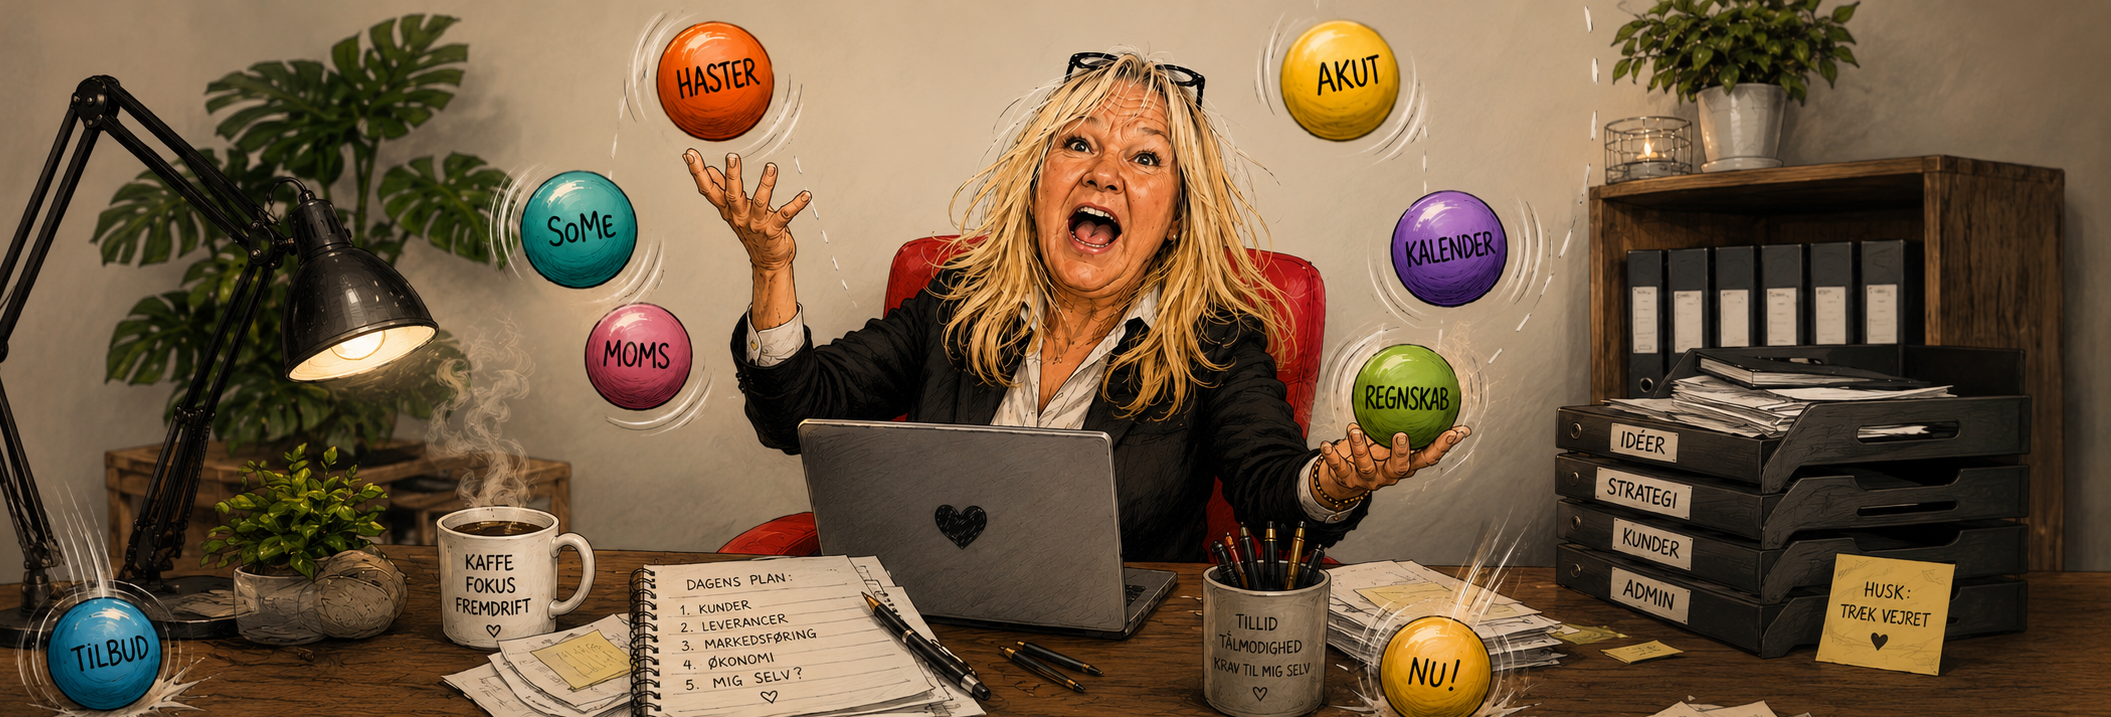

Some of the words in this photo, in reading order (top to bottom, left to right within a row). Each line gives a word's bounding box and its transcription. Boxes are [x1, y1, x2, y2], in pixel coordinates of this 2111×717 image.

[676, 57, 760, 99] HASTER
[1317, 54, 1380, 96] AKUT
[1405, 230, 1496, 268] KALENDER
[602, 339, 670, 370] MOMS
[1365, 384, 1449, 411] REGNSKAB
[1620, 429, 1666, 455] IDÉER
[1607, 477, 1677, 509] STRATEGI
[1622, 527, 1680, 559] KUNDER
[465, 553, 514, 572] KAFFE
[465, 575, 516, 594] FOKUS
[686, 576, 741, 591] DAGENS
[749, 572, 793, 586] PLAN:
[1864, 581, 1911, 600] HUSK:
[455, 597, 532, 617] FREMDRIFT
[1623, 579, 1675, 611] ADMIN
[680, 605, 690, 616] 1.
[698, 599, 752, 613] KUNDER
[1840, 603, 1877, 622] TRÆK
[1882, 608, 1932, 628] VEJRET
[680, 622, 693, 634] 2.
[702, 613, 788, 632] LEVERANCER
[1235, 613, 1278, 632] TILLID
[681, 640, 694, 652] 3.
[704, 628, 817, 650] MARKEDSFØRING
[1219, 631, 1302, 656] TÅLMODIGHED
[683, 659, 696, 671] 4.
[708, 652, 774, 670] ØKONOMI
[1213, 657, 1240, 674] KRAV
[1243, 663, 1258, 677] TIL
[1261, 664, 1284, 678] MIG
[1286, 662, 1311, 677] SELV
[686, 679, 699, 691] 5.
[712, 675, 743, 688] MIG
[1407, 656, 1461, 692] NU!
